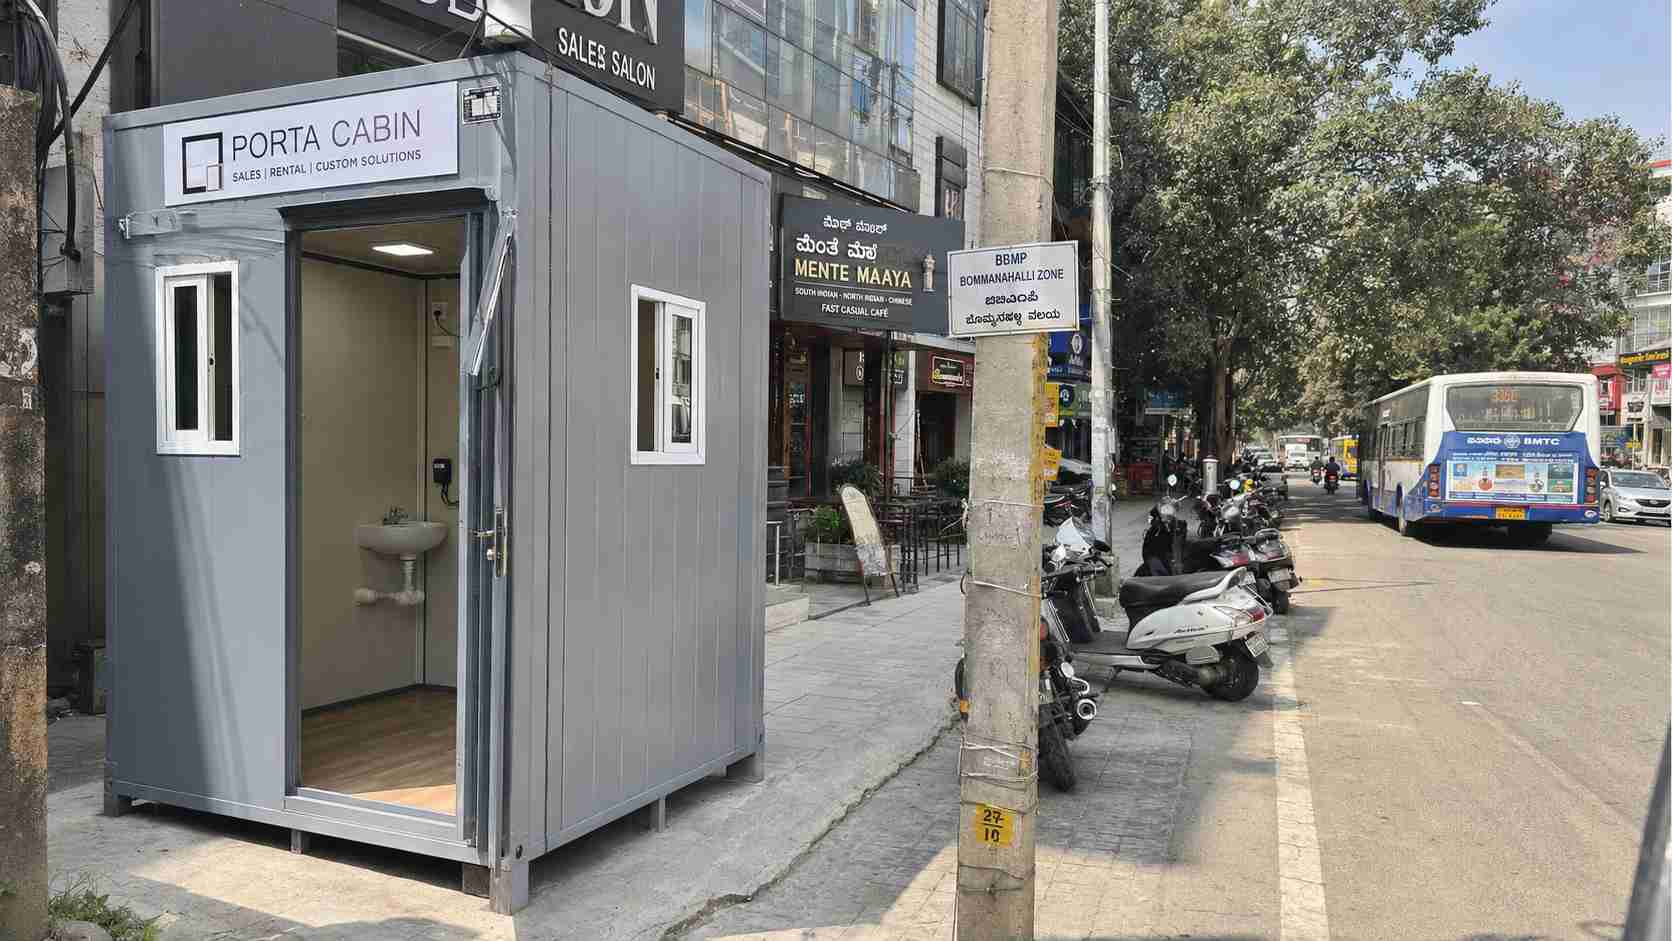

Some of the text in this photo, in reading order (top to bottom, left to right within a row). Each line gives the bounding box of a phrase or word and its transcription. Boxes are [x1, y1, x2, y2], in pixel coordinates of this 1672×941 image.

[611, 50, 656, 90] SALON
[232, 109, 422, 161] PORTA CABIN
[232, 169, 262, 183] SALES
[269, 164, 306, 178] RENTAL
[315, 158, 358, 173] CUSTOM
[360, 149, 422, 167] SOLUTIONS
[995, 252, 1028, 266] BBMP
[794, 257, 912, 289] MENTE MAAYA
[960, 268, 1064, 287] BOMMANAHALLI ZONE
[821, 303, 839, 314] FAST
[840, 305, 869, 316] CASUAL
[1523, 437, 1561, 446] BMTC
[984, 827, 1000, 843] 10
